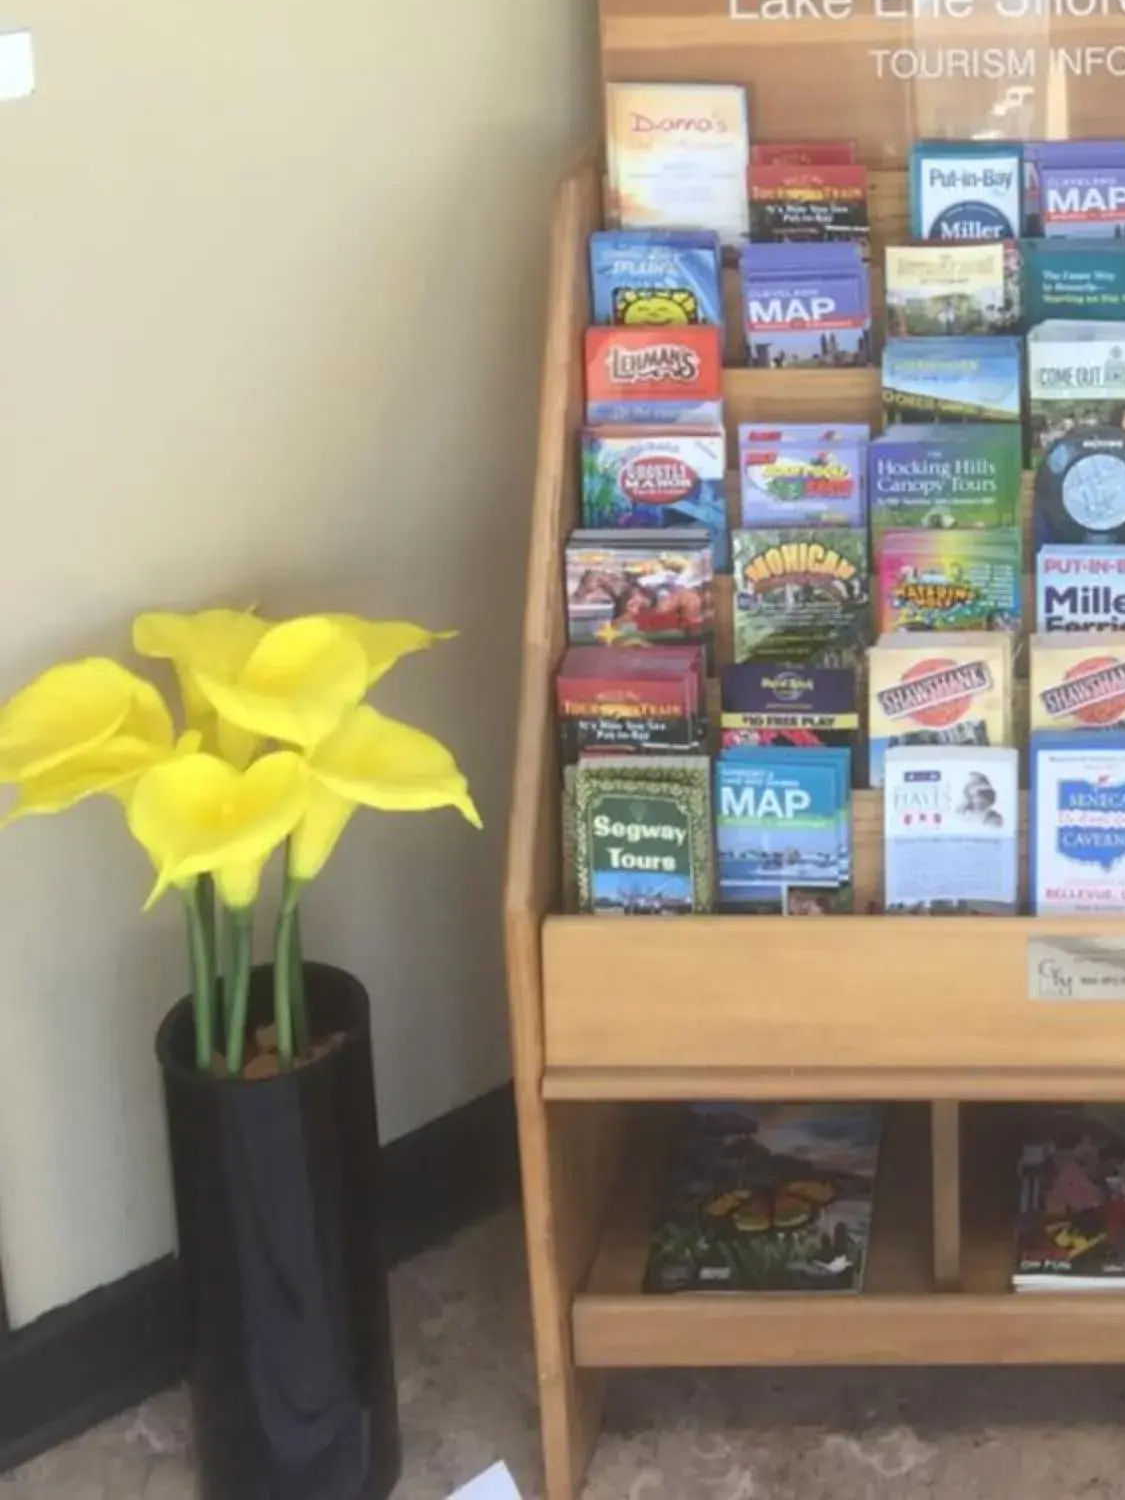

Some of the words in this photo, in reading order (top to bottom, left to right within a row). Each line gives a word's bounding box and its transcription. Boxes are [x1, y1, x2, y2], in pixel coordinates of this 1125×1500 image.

[870, 49, 1034, 78] TOURISM
[929, 167, 1012, 190] Put-in-Bay
[941, 220, 1004, 240] Miller
[749, 297, 835, 324] MAP
[877, 459, 950, 479] Hocking
[954, 458, 996, 477] Hills
[877, 480, 944, 497] Canopy
[952, 478, 997, 493] Tours
[721, 786, 811, 818] MAP
[593, 815, 687, 846] Segway
[608, 847, 676, 870] Tours
